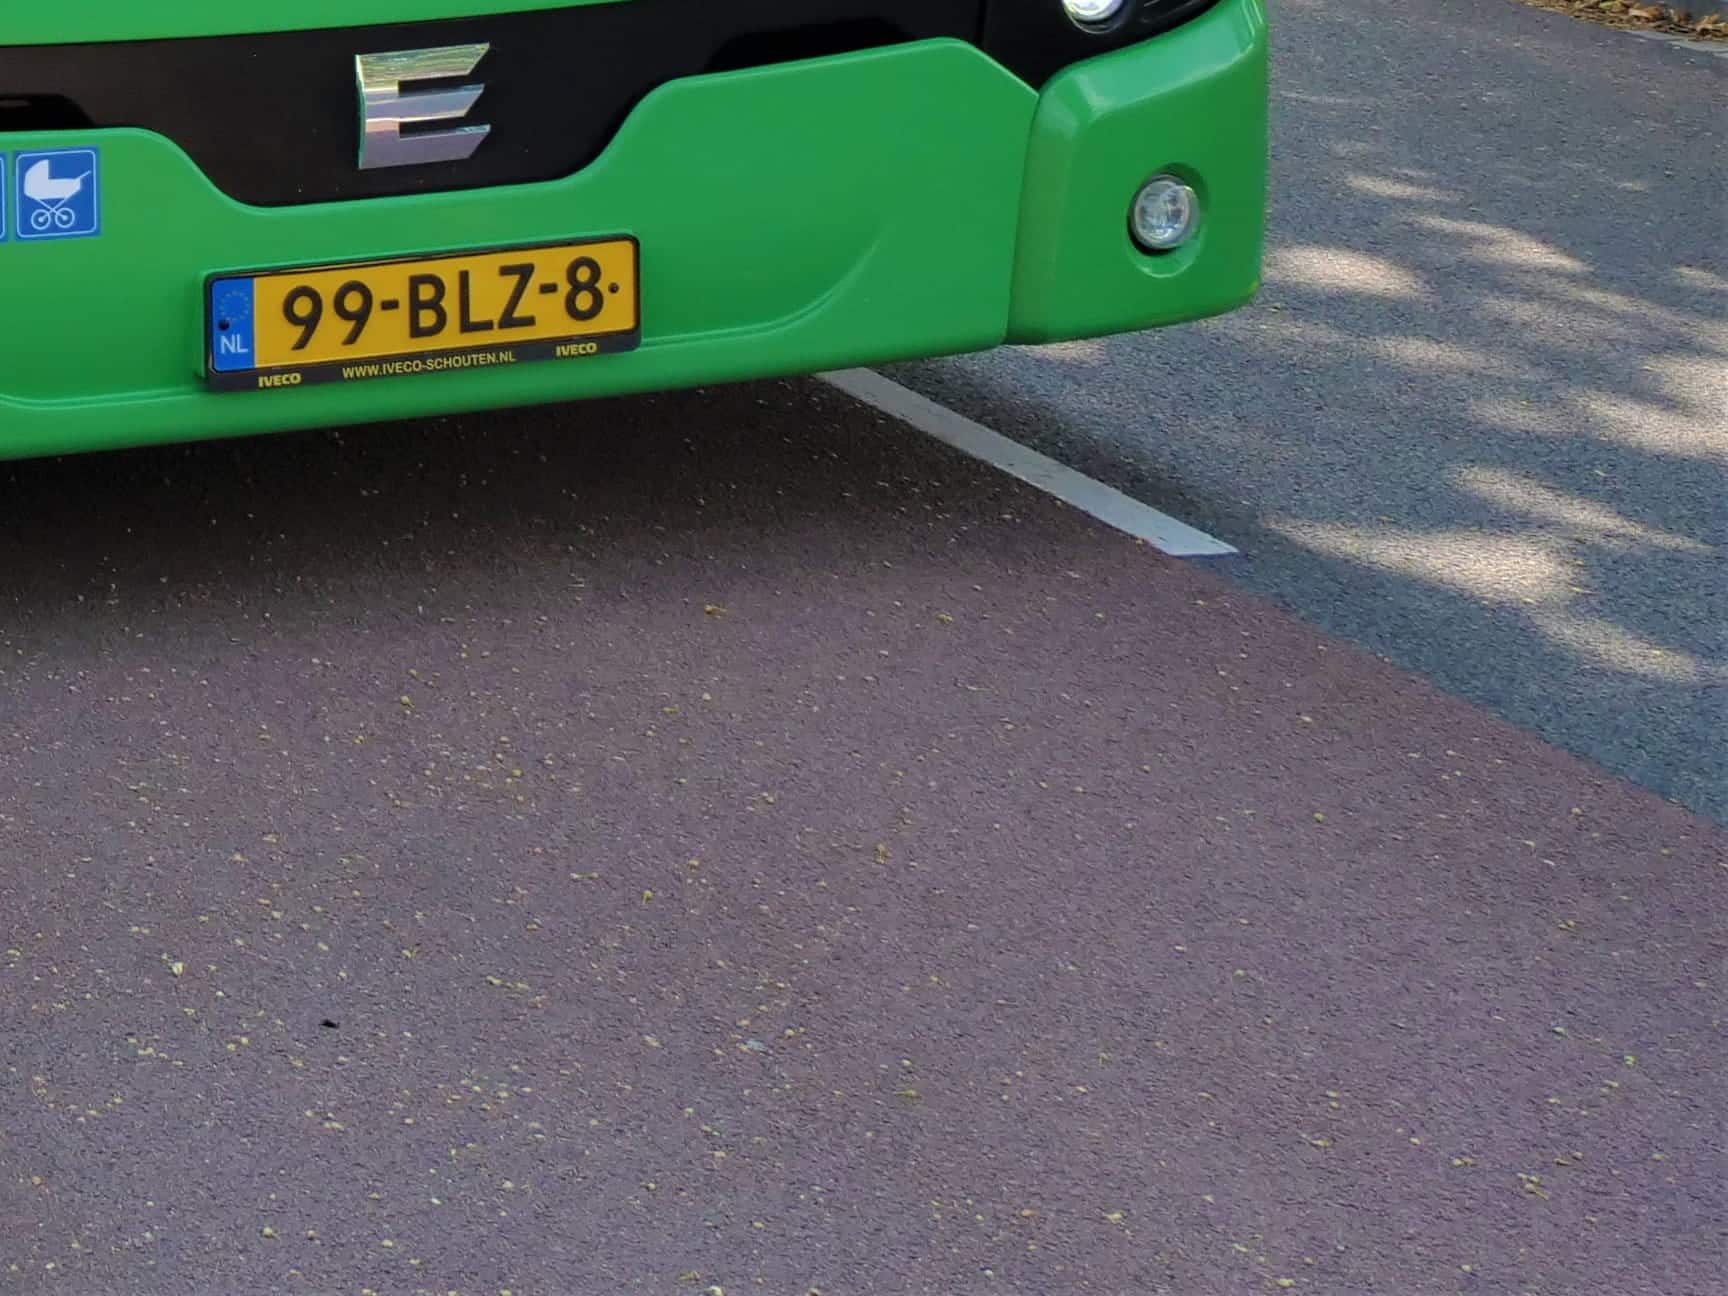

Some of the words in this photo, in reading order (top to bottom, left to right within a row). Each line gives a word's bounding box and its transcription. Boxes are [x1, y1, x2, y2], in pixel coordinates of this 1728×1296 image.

[220, 334, 248, 355] NL
[282, 255, 605, 352] 99-BLZ-8
[258, 371, 302, 389] IVECO
[342, 350, 517, 380] WWW.IVECO-SCHOUTEN.NL
[555, 341, 598, 359] IVECO
